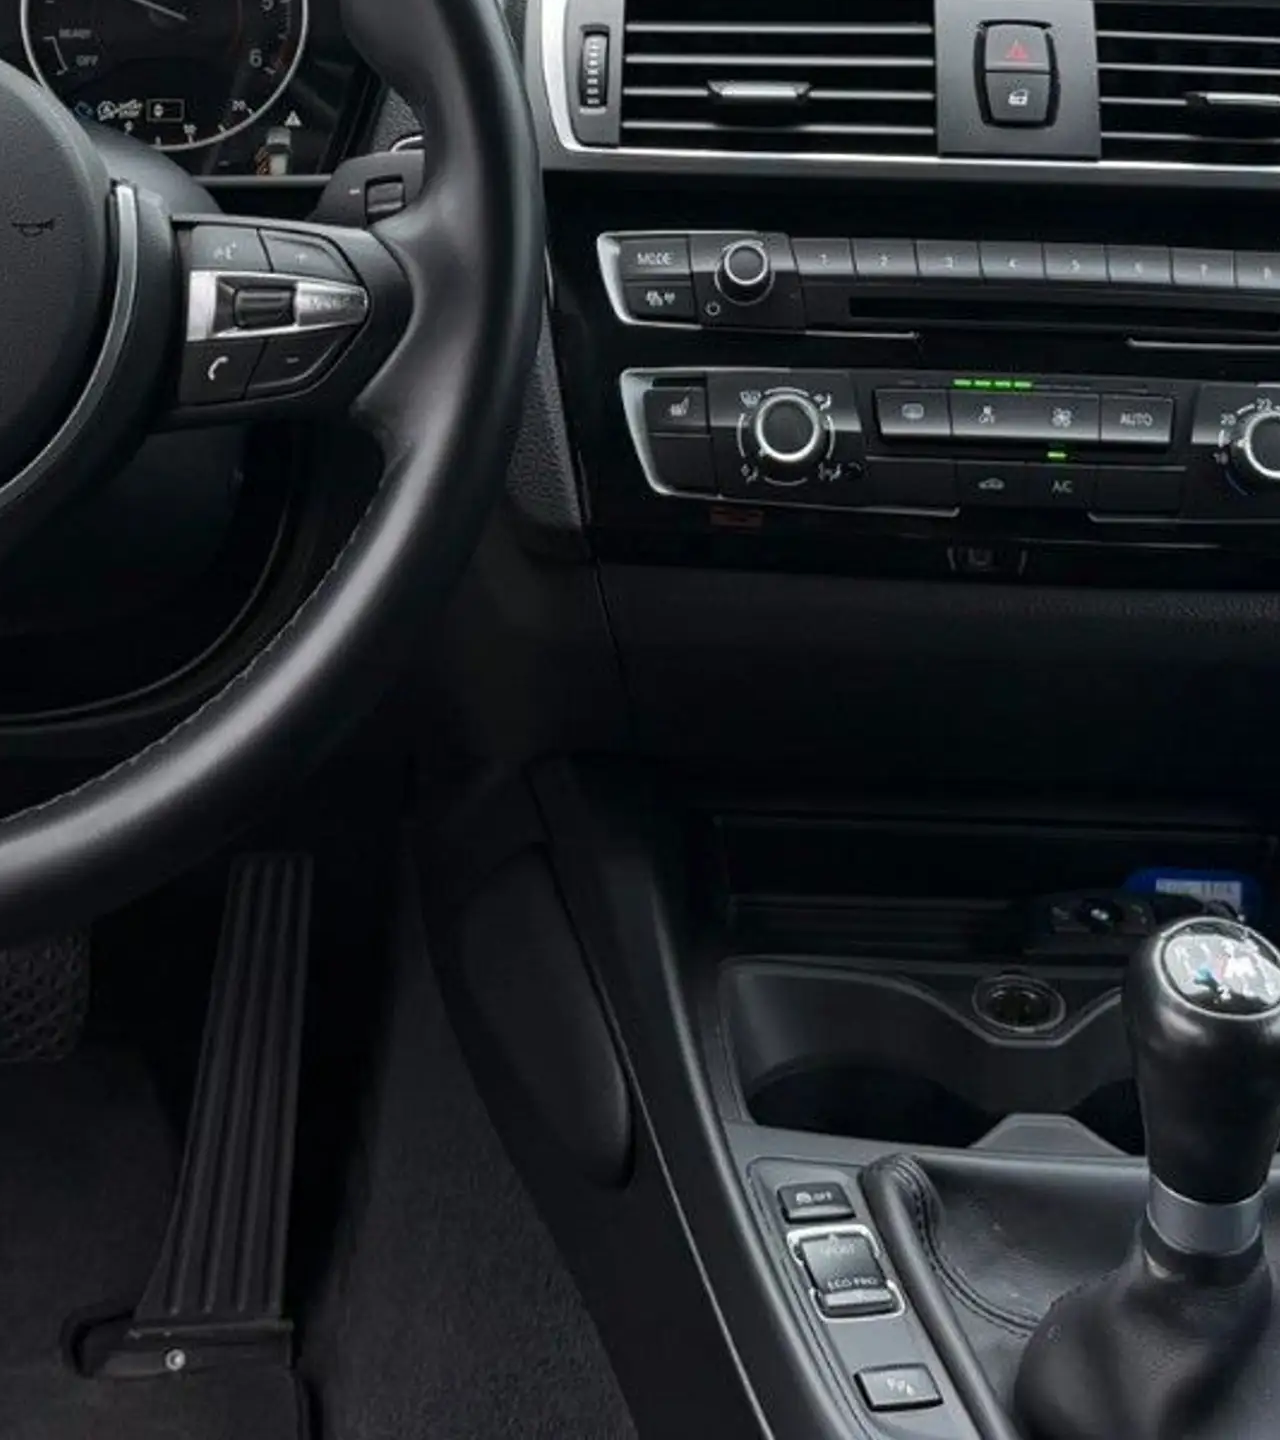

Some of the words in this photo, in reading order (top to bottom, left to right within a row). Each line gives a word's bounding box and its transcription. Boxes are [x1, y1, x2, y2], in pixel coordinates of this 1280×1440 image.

[249, 48, 263, 67] 6
[636, 251, 673, 265] MODE
[1119, 413, 1153, 427] AUTO
[1051, 480, 1073, 494] A/C
